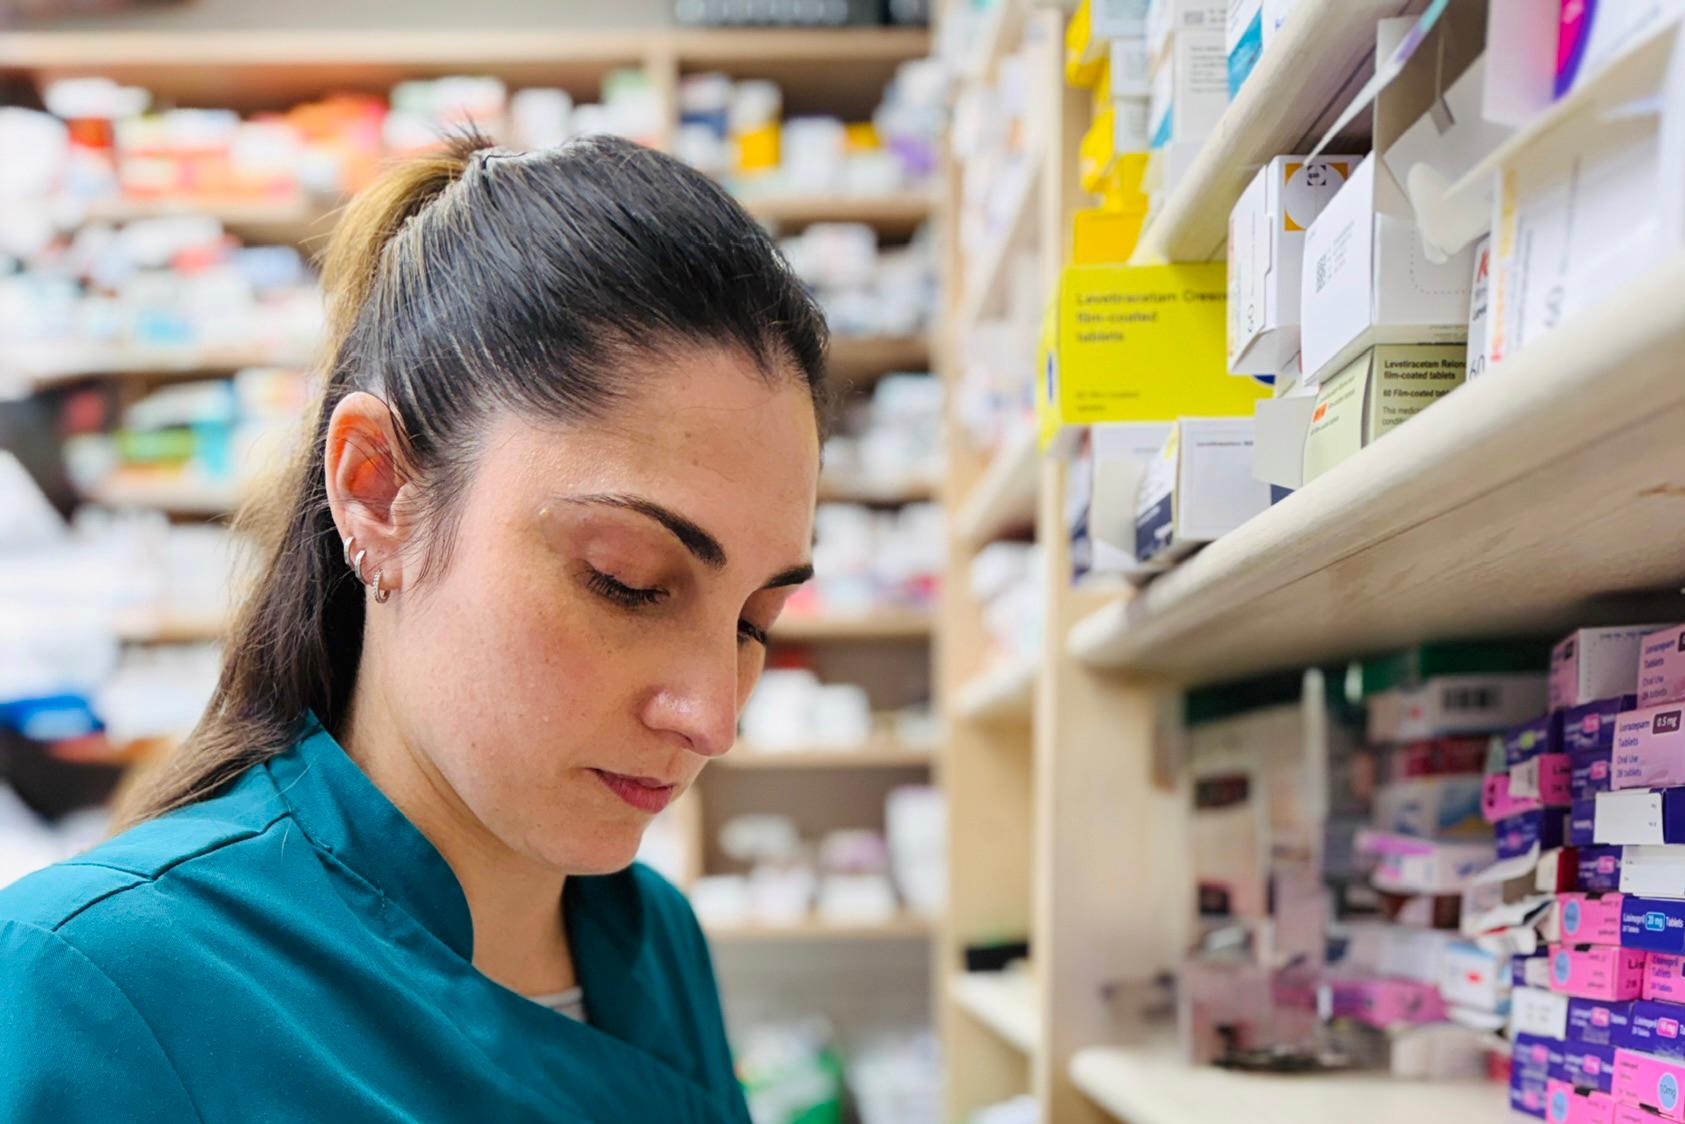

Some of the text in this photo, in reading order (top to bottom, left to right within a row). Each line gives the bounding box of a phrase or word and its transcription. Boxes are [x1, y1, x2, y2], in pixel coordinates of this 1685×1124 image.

[1077, 312, 1158, 323] film-coated
[1077, 331, 1124, 342] tablets
[1384, 360, 1440, 369] Levetiracetam
[1384, 371, 1456, 380] film-coated tablets
[1393, 389, 1433, 398] Film-coated
[1620, 720, 1650, 732] Lorazepam
[1656, 717, 1667, 728] 0.5
[1618, 737, 1639, 748] Tablets
[1622, 913, 1645, 926] Lisinopril
[1665, 915, 1684, 929] Tablets
